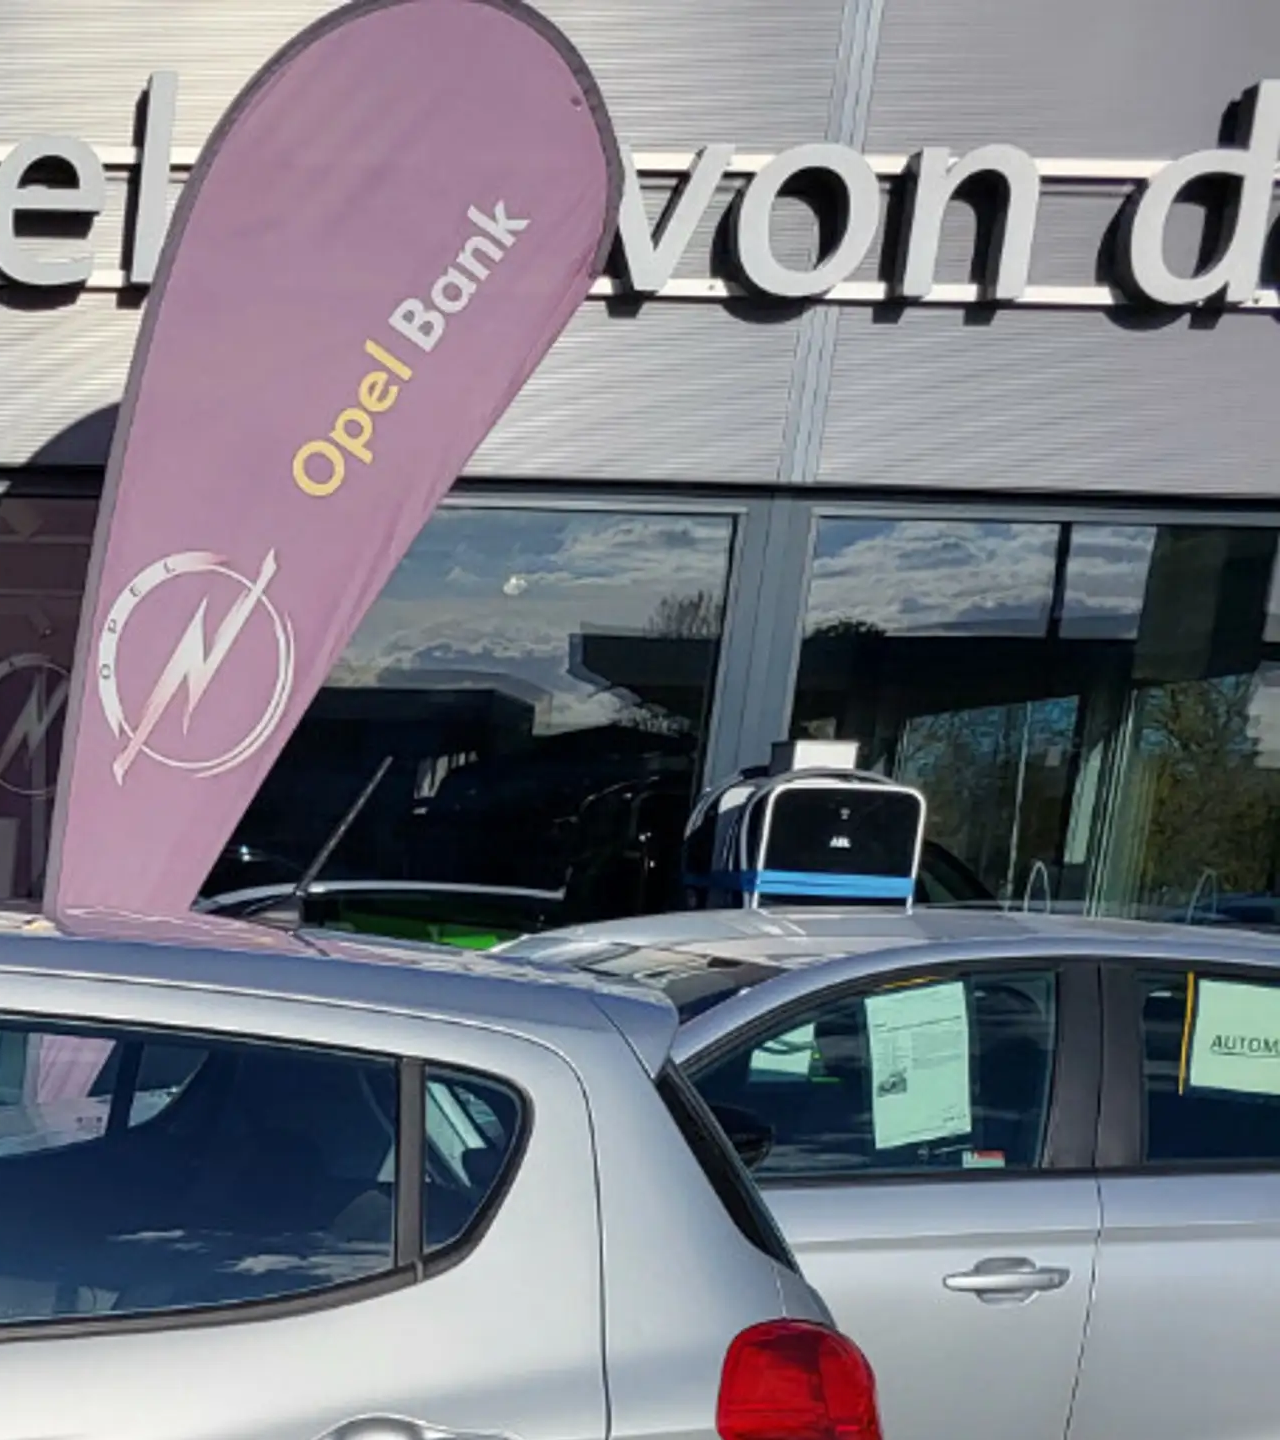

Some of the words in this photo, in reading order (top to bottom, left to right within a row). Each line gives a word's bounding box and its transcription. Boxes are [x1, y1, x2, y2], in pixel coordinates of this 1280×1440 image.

[617, 142, 1041, 301] von
[292, 338, 413, 497] Opel
[388, 199, 532, 353] Bank
